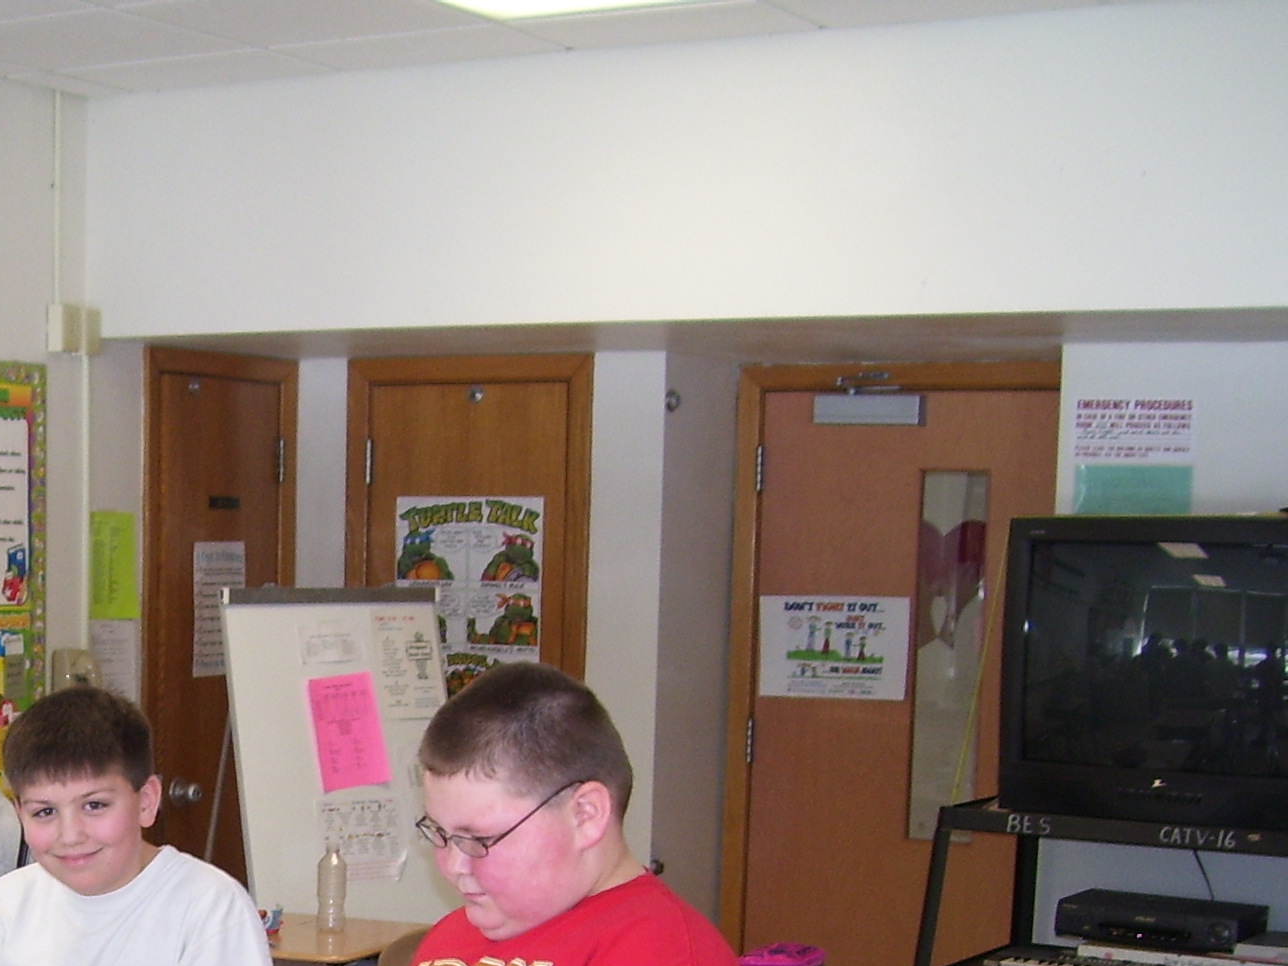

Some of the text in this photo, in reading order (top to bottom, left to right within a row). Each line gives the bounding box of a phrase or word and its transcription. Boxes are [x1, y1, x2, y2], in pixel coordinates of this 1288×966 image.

[1077, 399, 1192, 411] EMERGENCY PROCEDURES
[399, 499, 540, 534] TURTLE TALK
[1159, 826, 1237, 849] CATV-16
